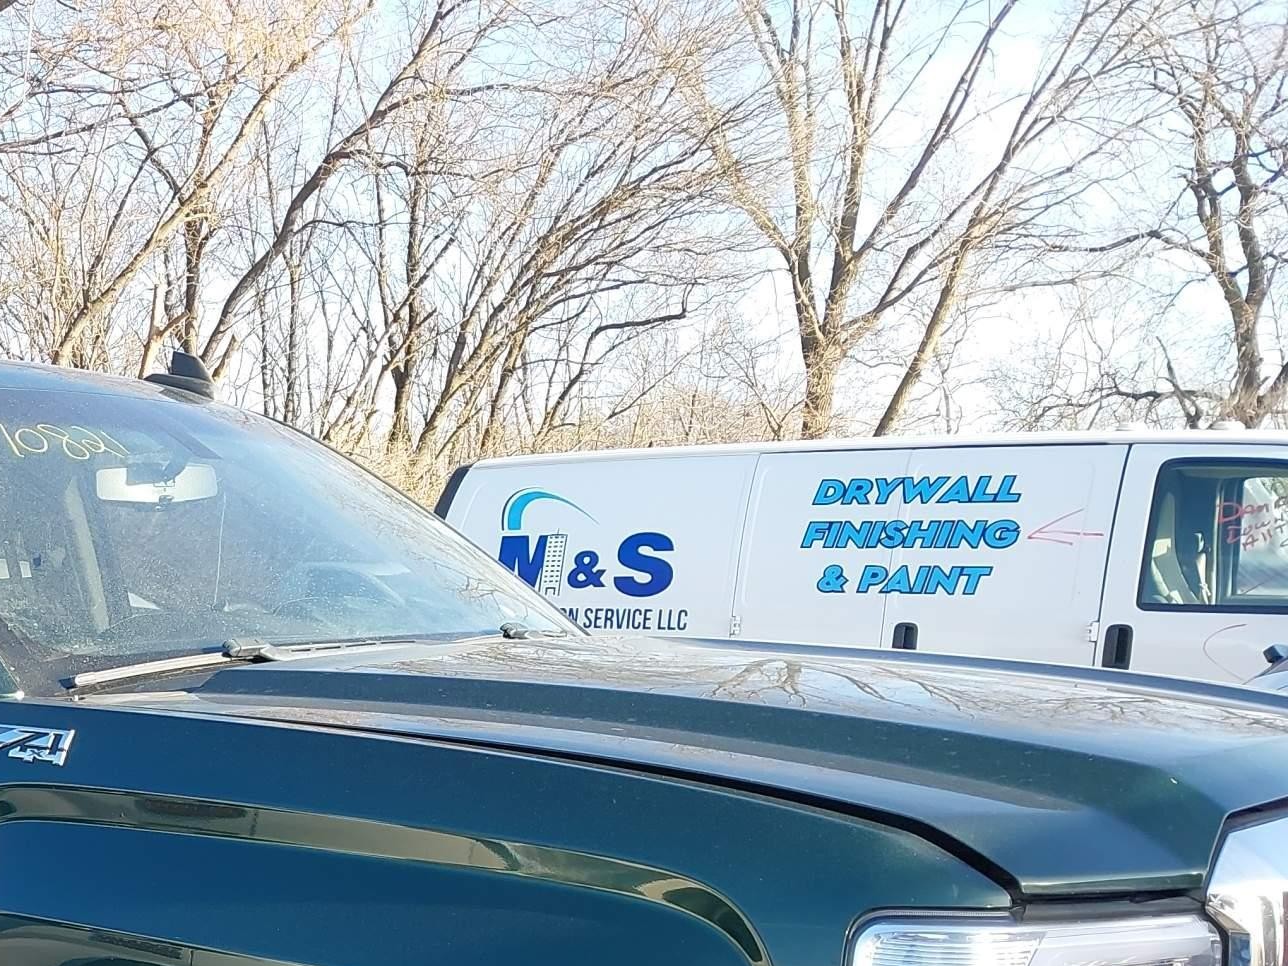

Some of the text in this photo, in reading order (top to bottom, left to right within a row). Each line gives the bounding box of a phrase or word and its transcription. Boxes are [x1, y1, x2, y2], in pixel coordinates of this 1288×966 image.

[812, 474, 1022, 506] DRYWALL
[800, 519, 1021, 549] FINISHING
[567, 550, 607, 589] &
[613, 531, 675, 597] S
[816, 563, 994, 595] & PAINT
[583, 607, 654, 630] SERVICE
[657, 608, 689, 631] LLC
